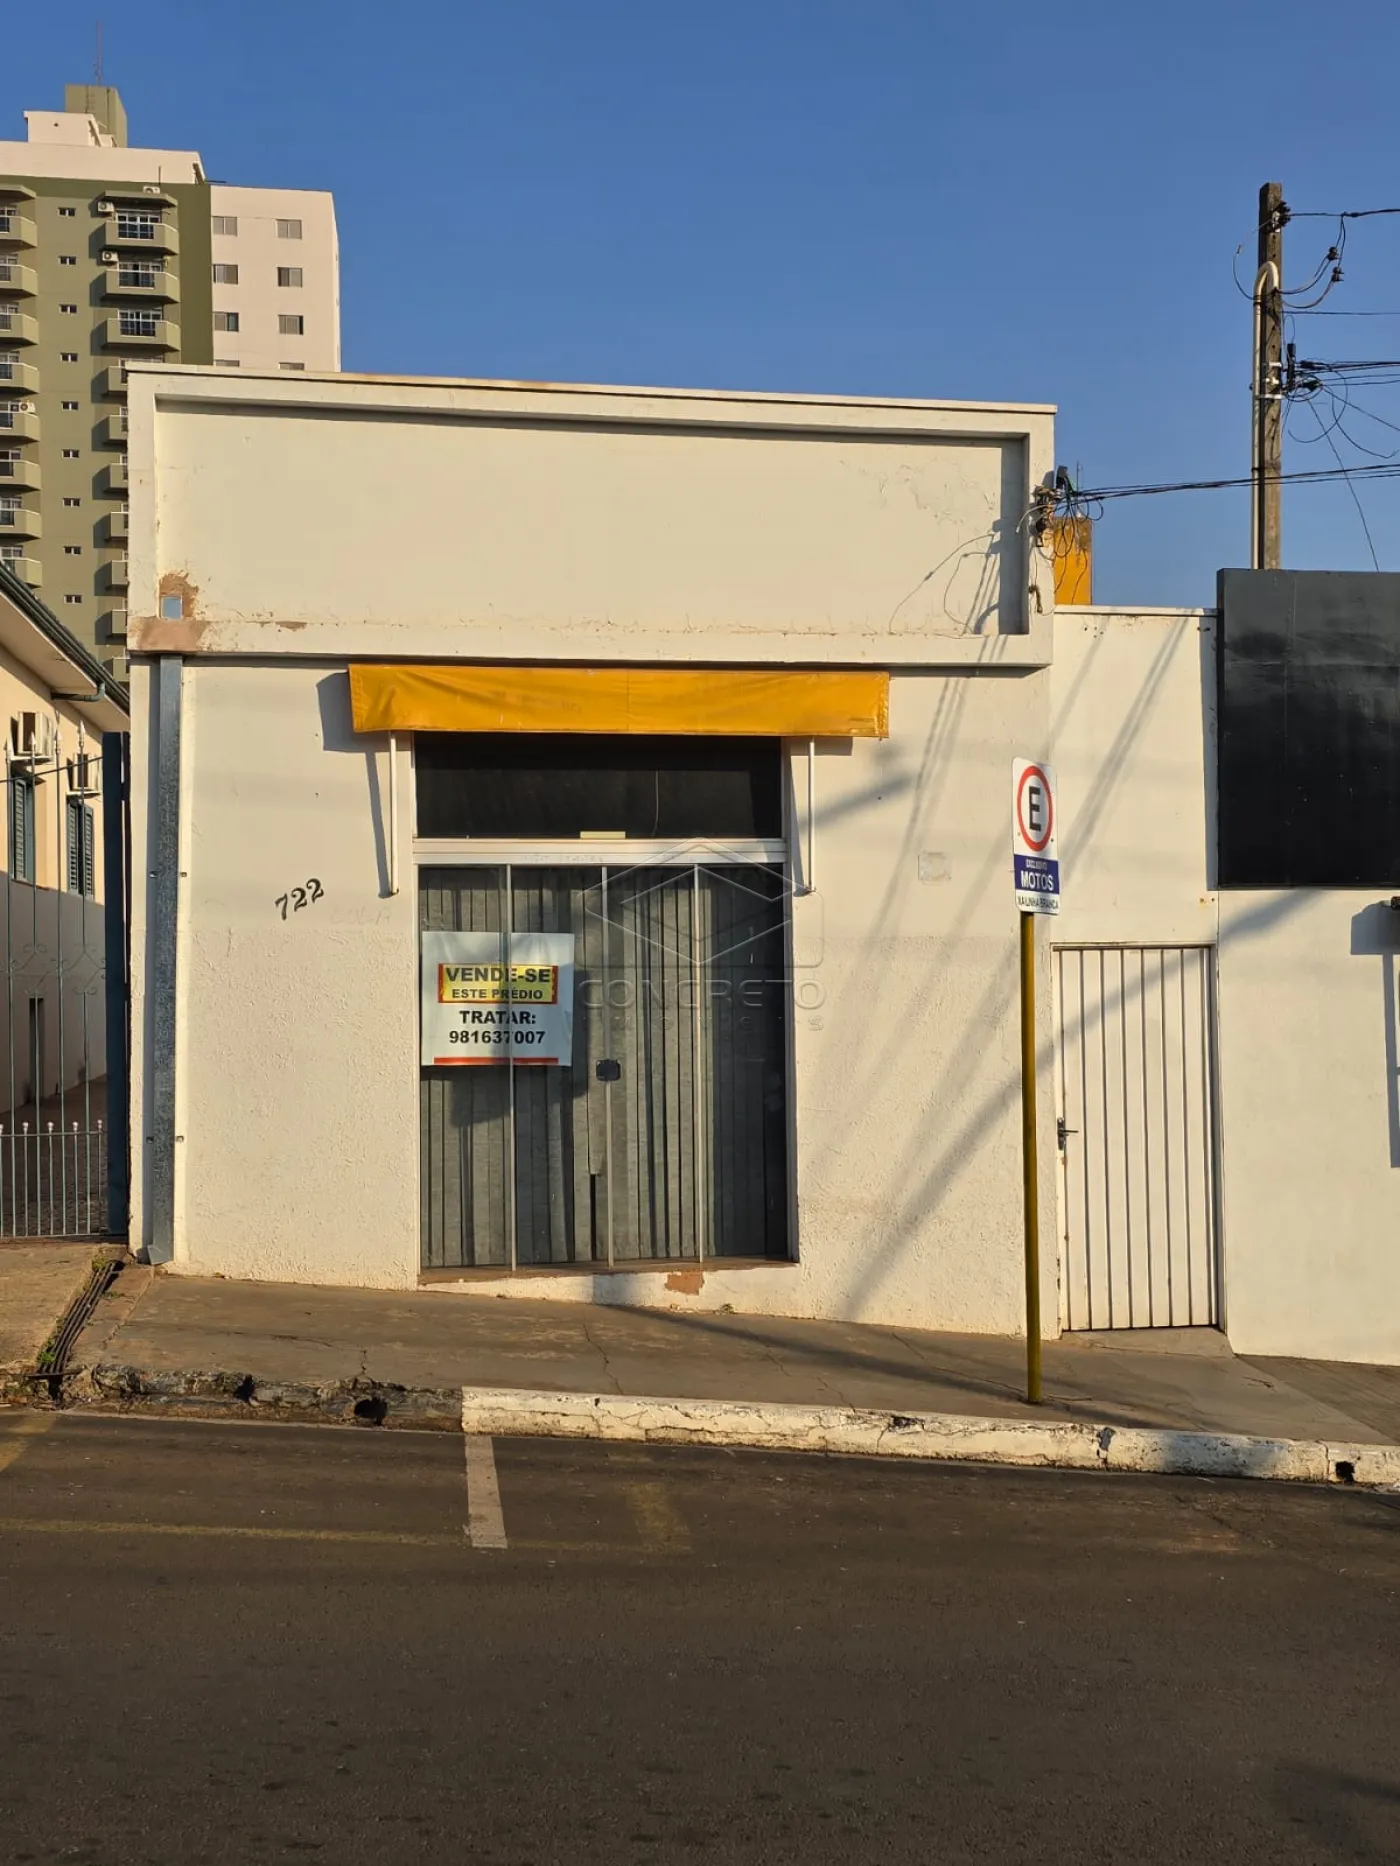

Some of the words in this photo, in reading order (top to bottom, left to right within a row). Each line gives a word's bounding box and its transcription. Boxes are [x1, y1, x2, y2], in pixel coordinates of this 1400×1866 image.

[1029, 786, 1041, 832] E
[1020, 870, 1054, 891] MOTOS
[275, 878, 324, 921] 722
[445, 967, 551, 983] VENDE-SE
[452, 988, 487, 999] ESTE
[459, 1010, 536, 1025] TRATAR:
[449, 1030, 546, 1044] 981637007
